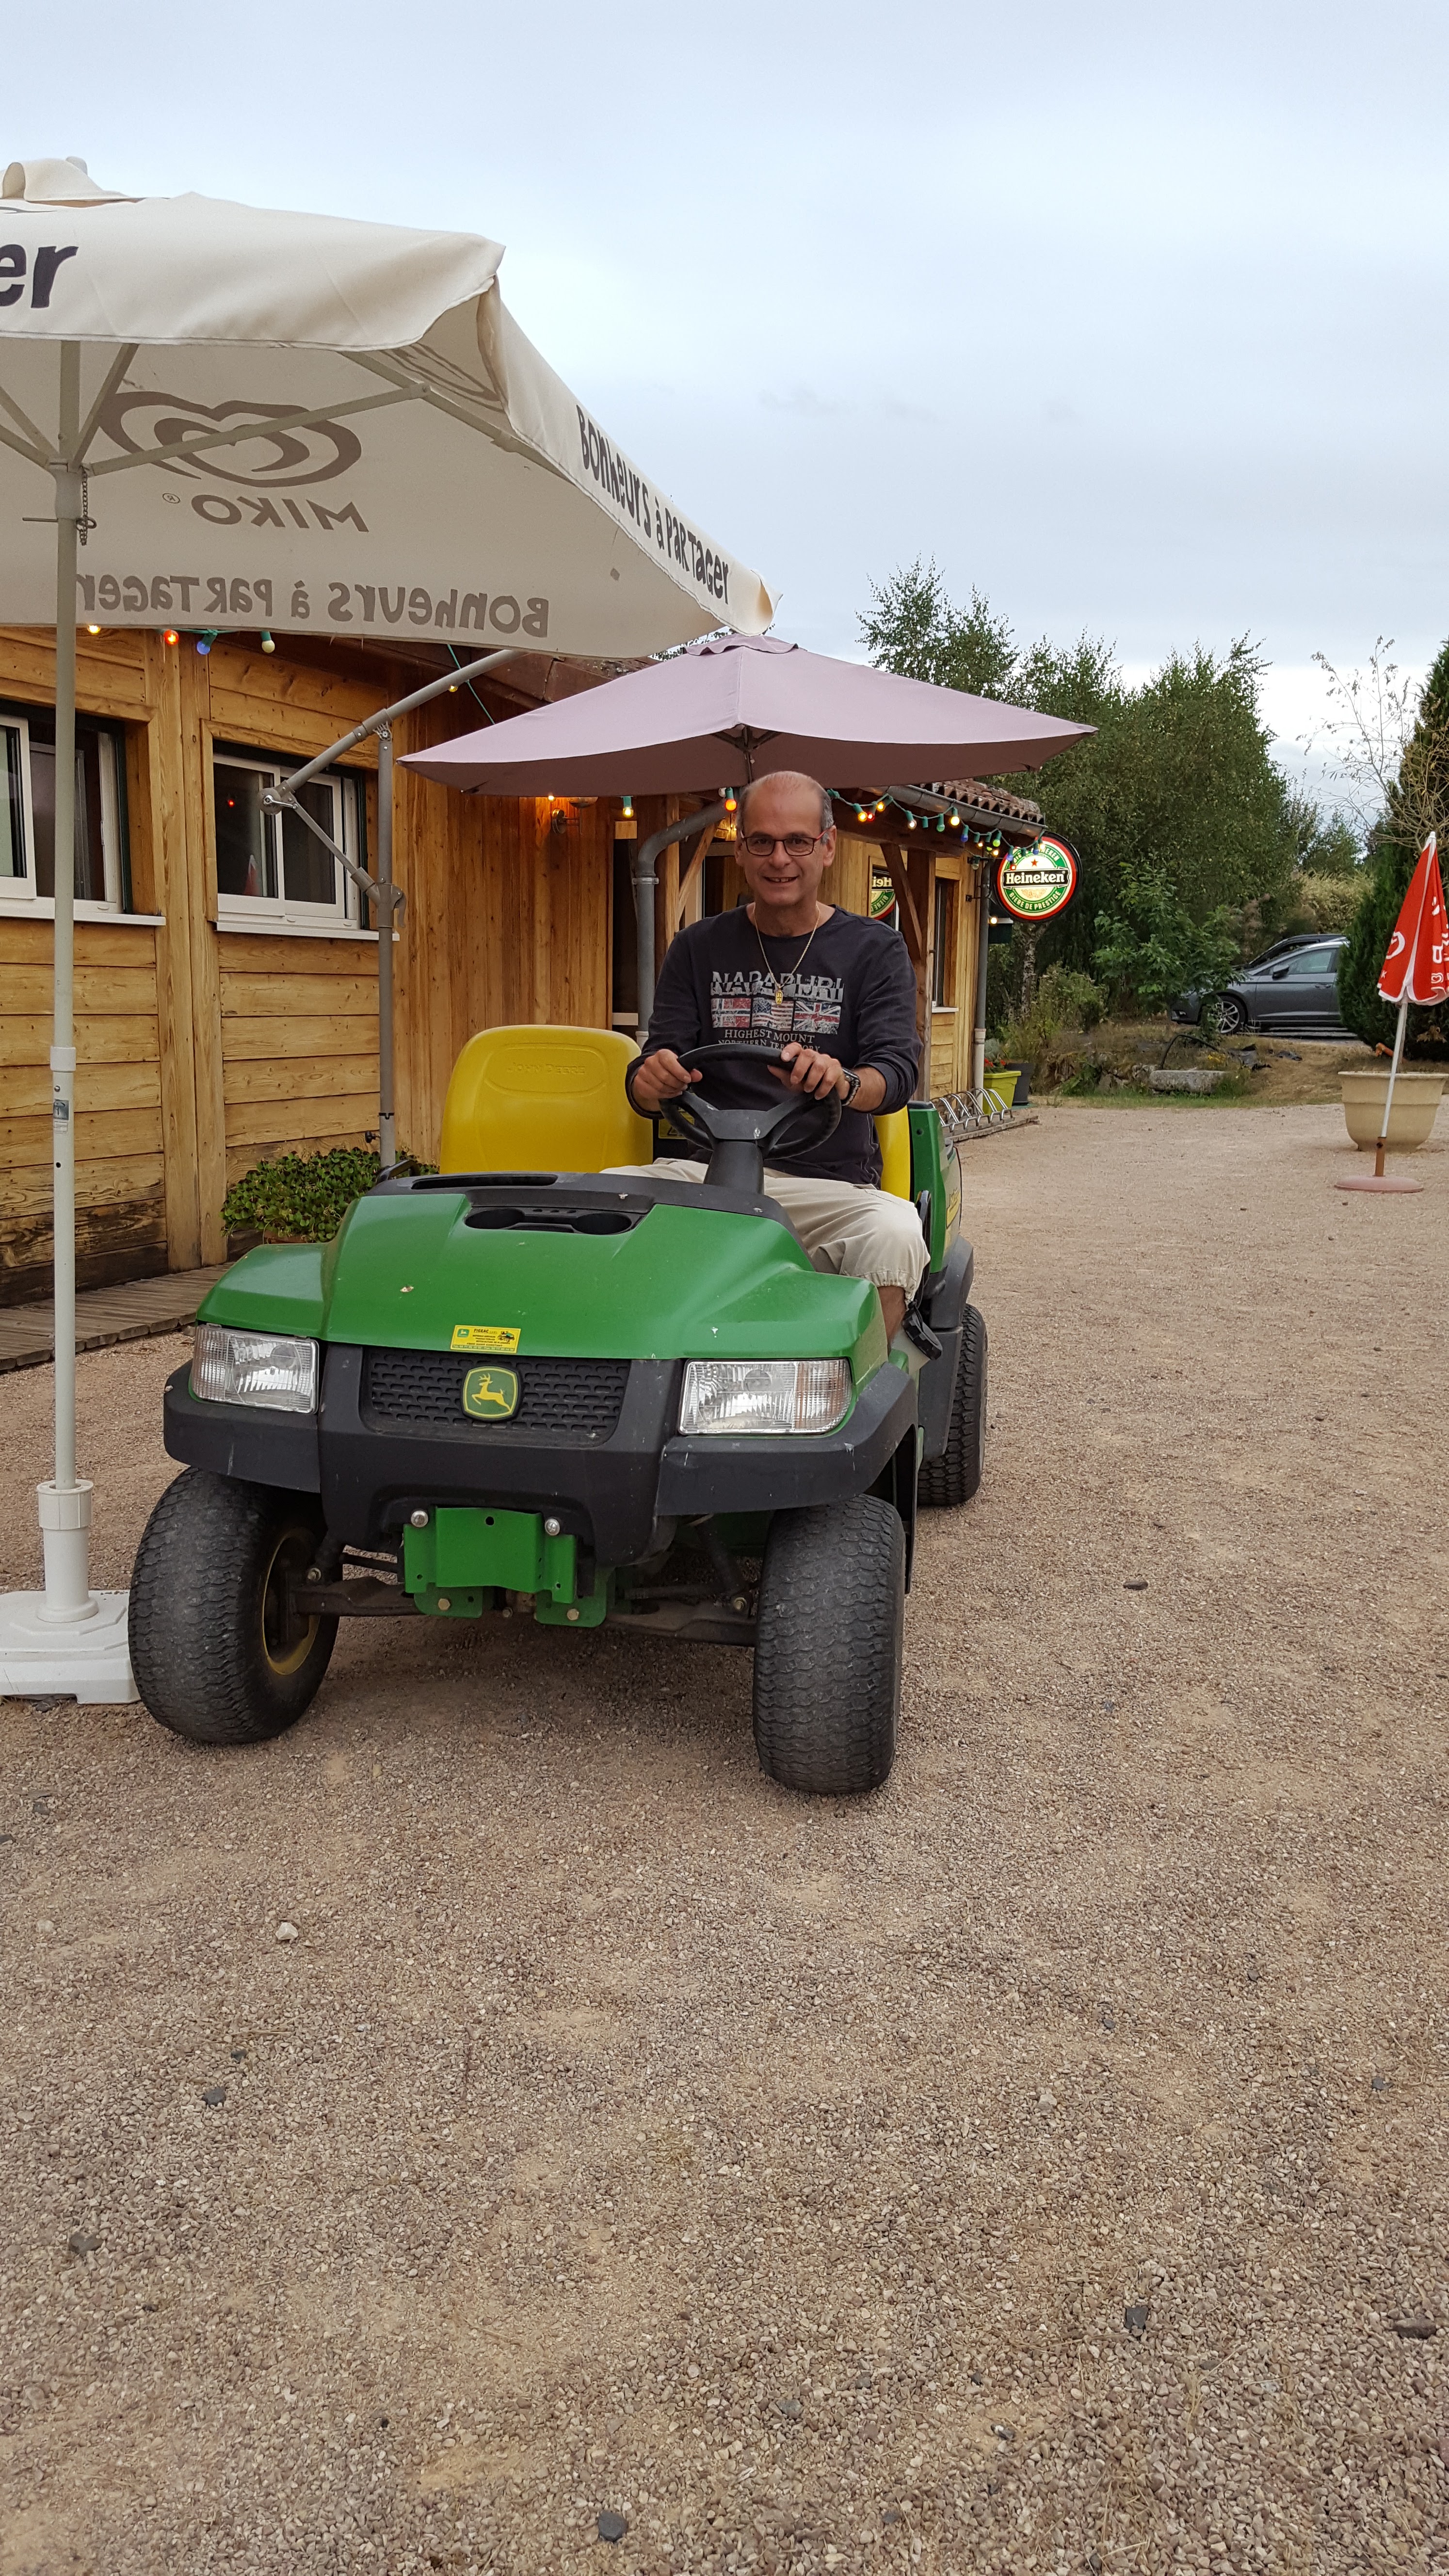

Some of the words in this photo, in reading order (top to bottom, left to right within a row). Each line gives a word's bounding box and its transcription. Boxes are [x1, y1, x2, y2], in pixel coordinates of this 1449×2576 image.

[655, 496, 664, 550] à
[1006, 871, 1065, 885] Heineken
[1009, 892, 1024, 907] BIERE
[1034, 890, 1062, 910] PRESTIGE
[724, 1029, 772, 1039] HIGHEST
[773, 1032, 815, 1043] MOUNT
